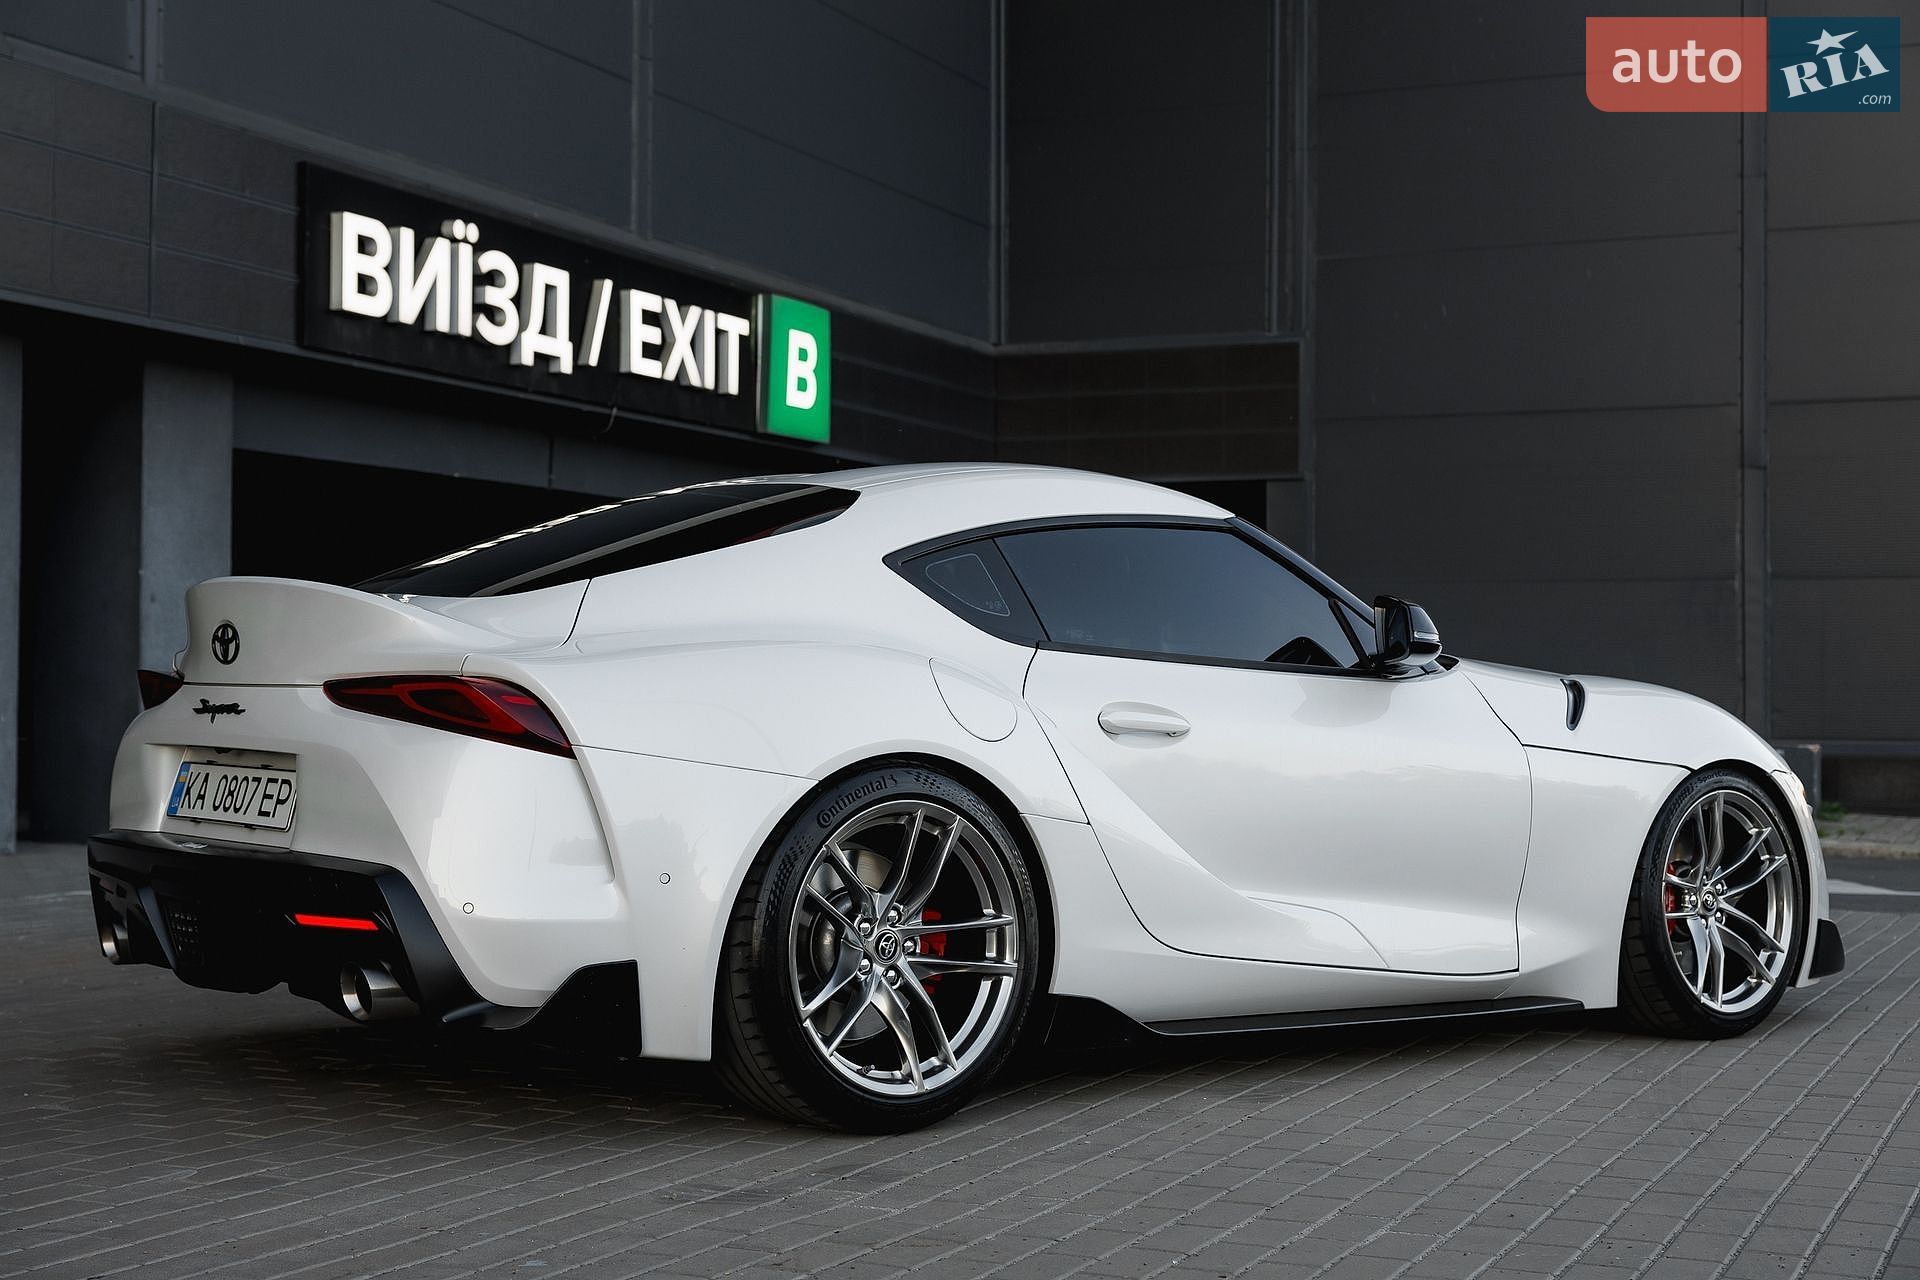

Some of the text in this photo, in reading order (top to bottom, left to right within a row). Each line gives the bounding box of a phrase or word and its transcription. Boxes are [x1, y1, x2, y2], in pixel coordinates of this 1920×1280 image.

[331, 211, 573, 375] ВИЇЗД
[622, 289, 750, 396] EXIT
[816, 774, 889, 829] Continental
